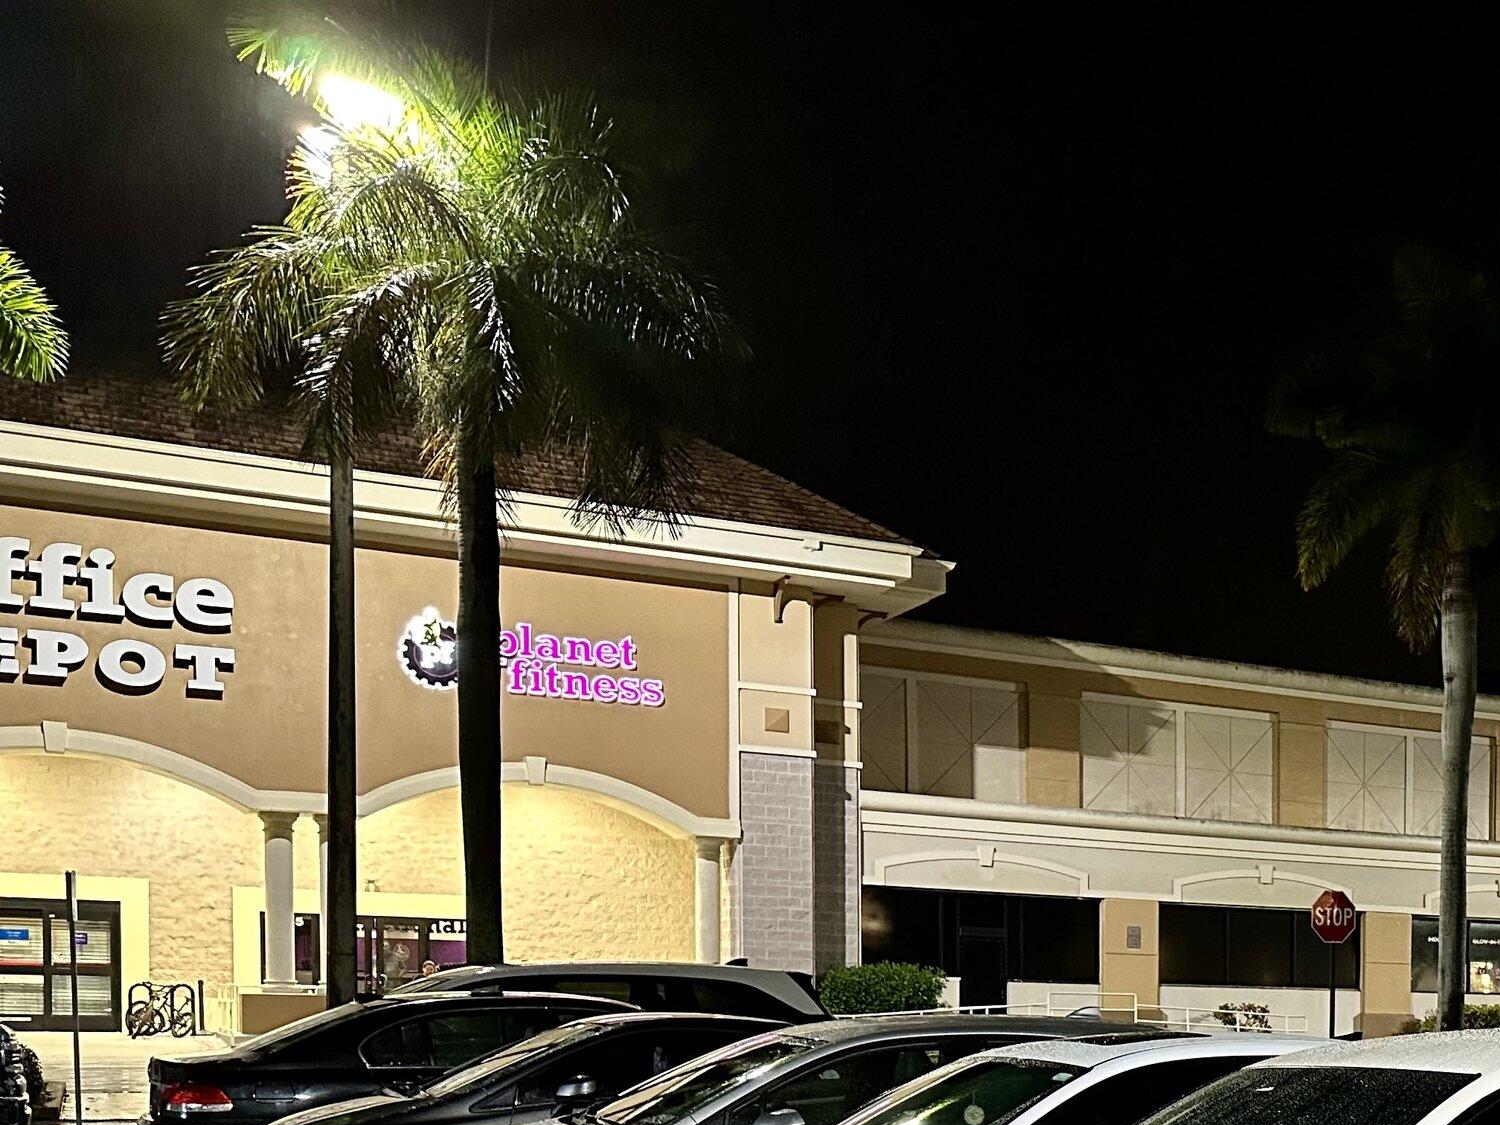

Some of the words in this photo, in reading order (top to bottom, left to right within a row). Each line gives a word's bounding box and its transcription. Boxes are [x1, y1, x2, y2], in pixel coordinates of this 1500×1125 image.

[0, 536, 234, 631] ffice
[0, 627, 236, 697] POT
[507, 659, 665, 707] fitness
[1315, 906, 1353, 926] STOP
